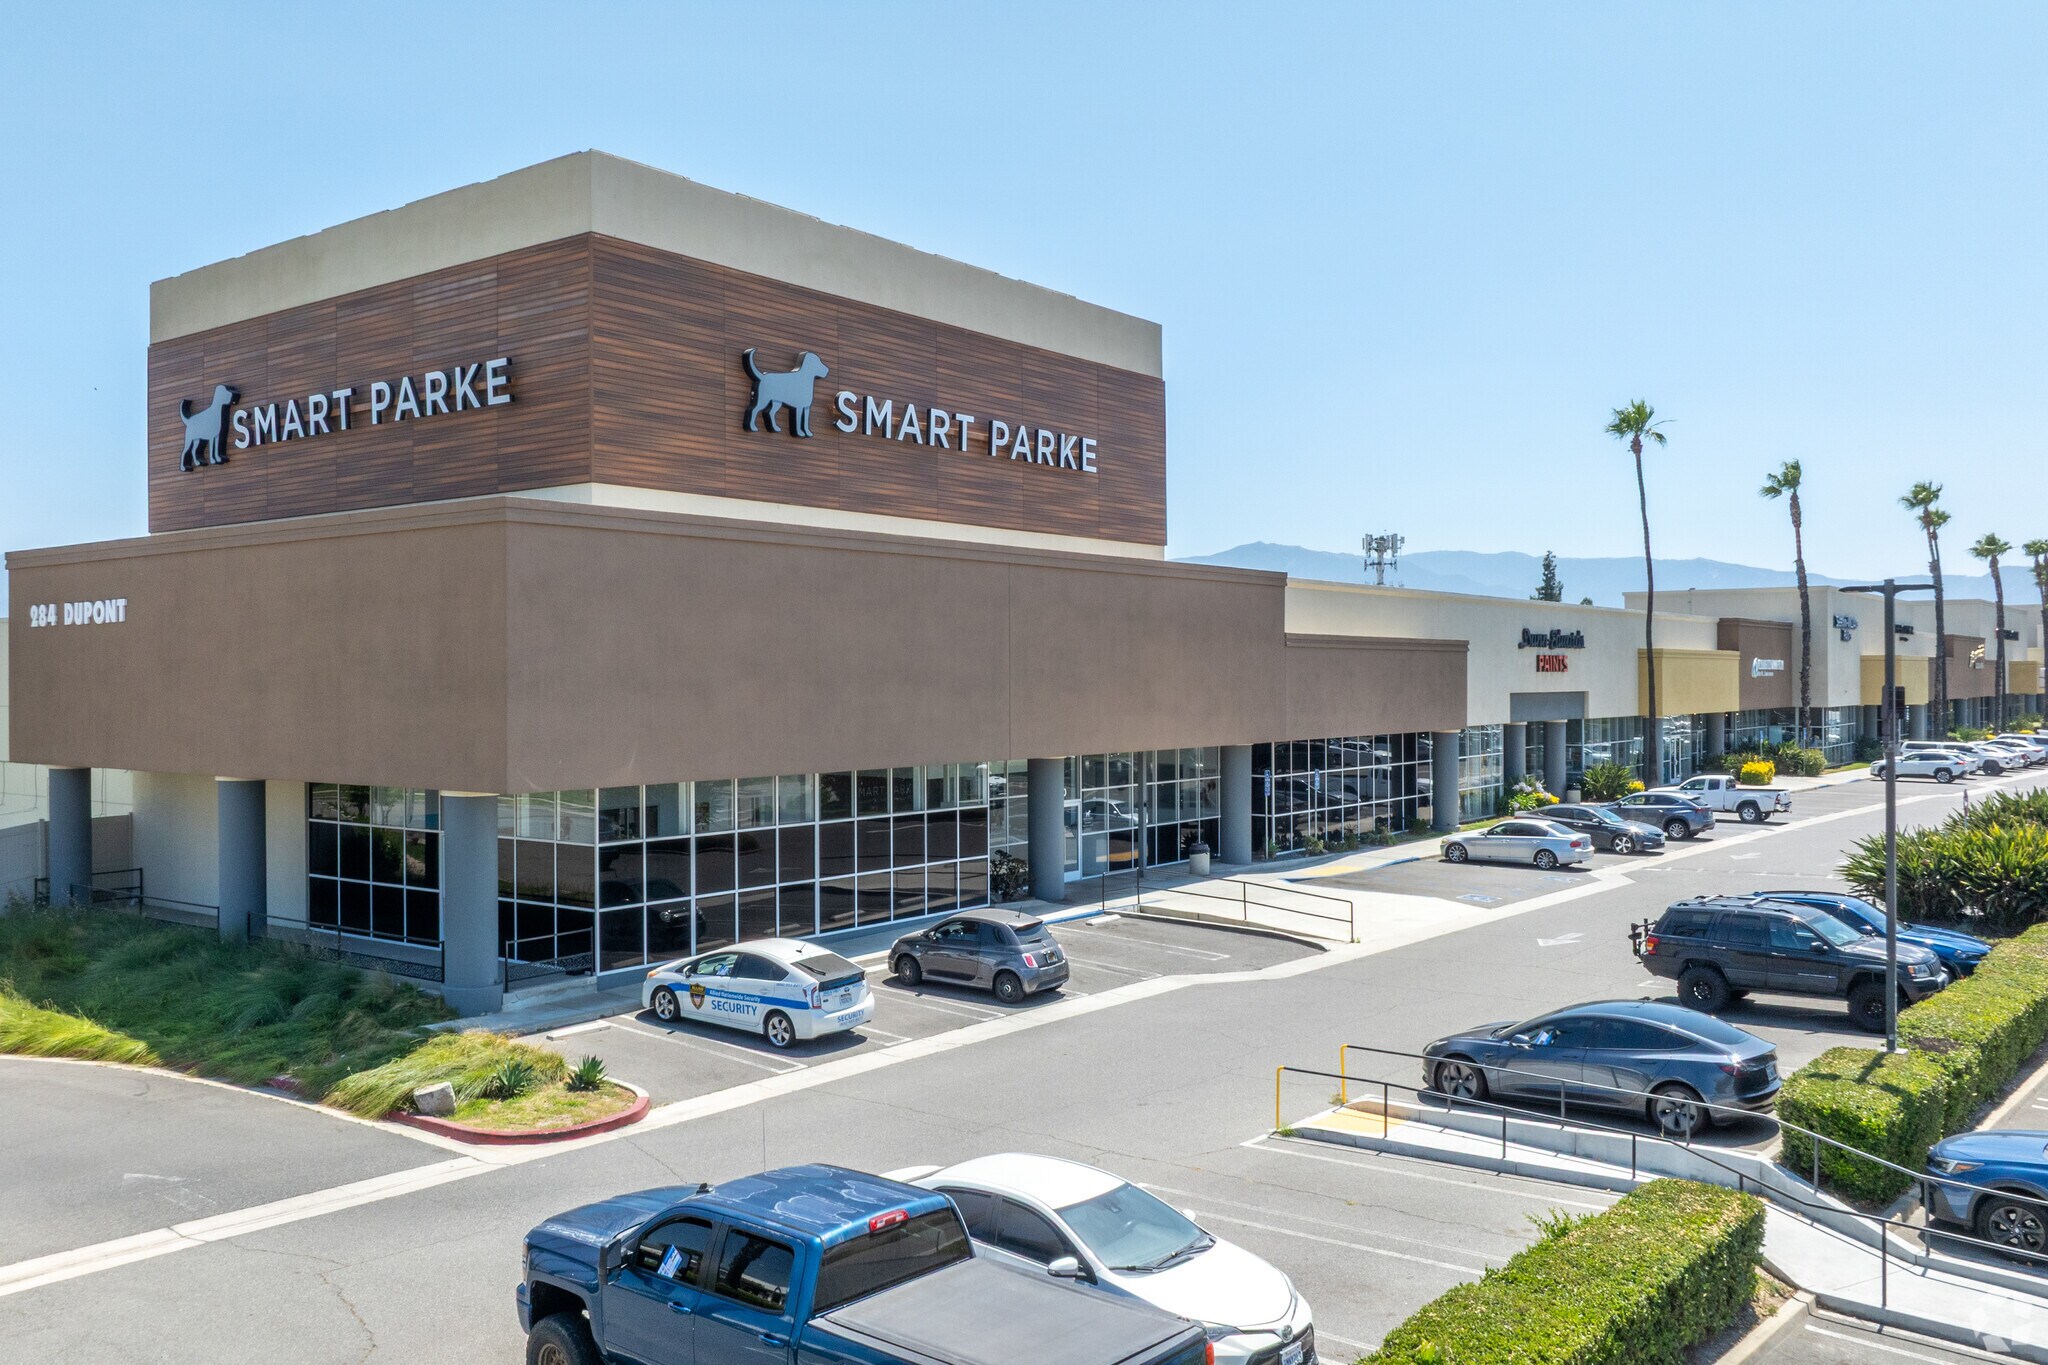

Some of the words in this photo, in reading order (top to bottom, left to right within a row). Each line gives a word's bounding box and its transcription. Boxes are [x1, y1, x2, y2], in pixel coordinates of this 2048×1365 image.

[233, 388, 357, 449] SMART
[371, 357, 514, 425] PARKE
[833, 391, 975, 452] SMART
[988, 419, 1098, 473] PARKE
[30, 604, 58, 627] 284
[64, 599, 128, 625] DUPONT
[1536, 654, 1568, 672] PAINTS
[721, 991, 744, 1000] Nationwide
[744, 995, 760, 1003] Security
[711, 1000, 758, 1016] SECURITY
[837, 1009, 865, 1023] SECURITY
